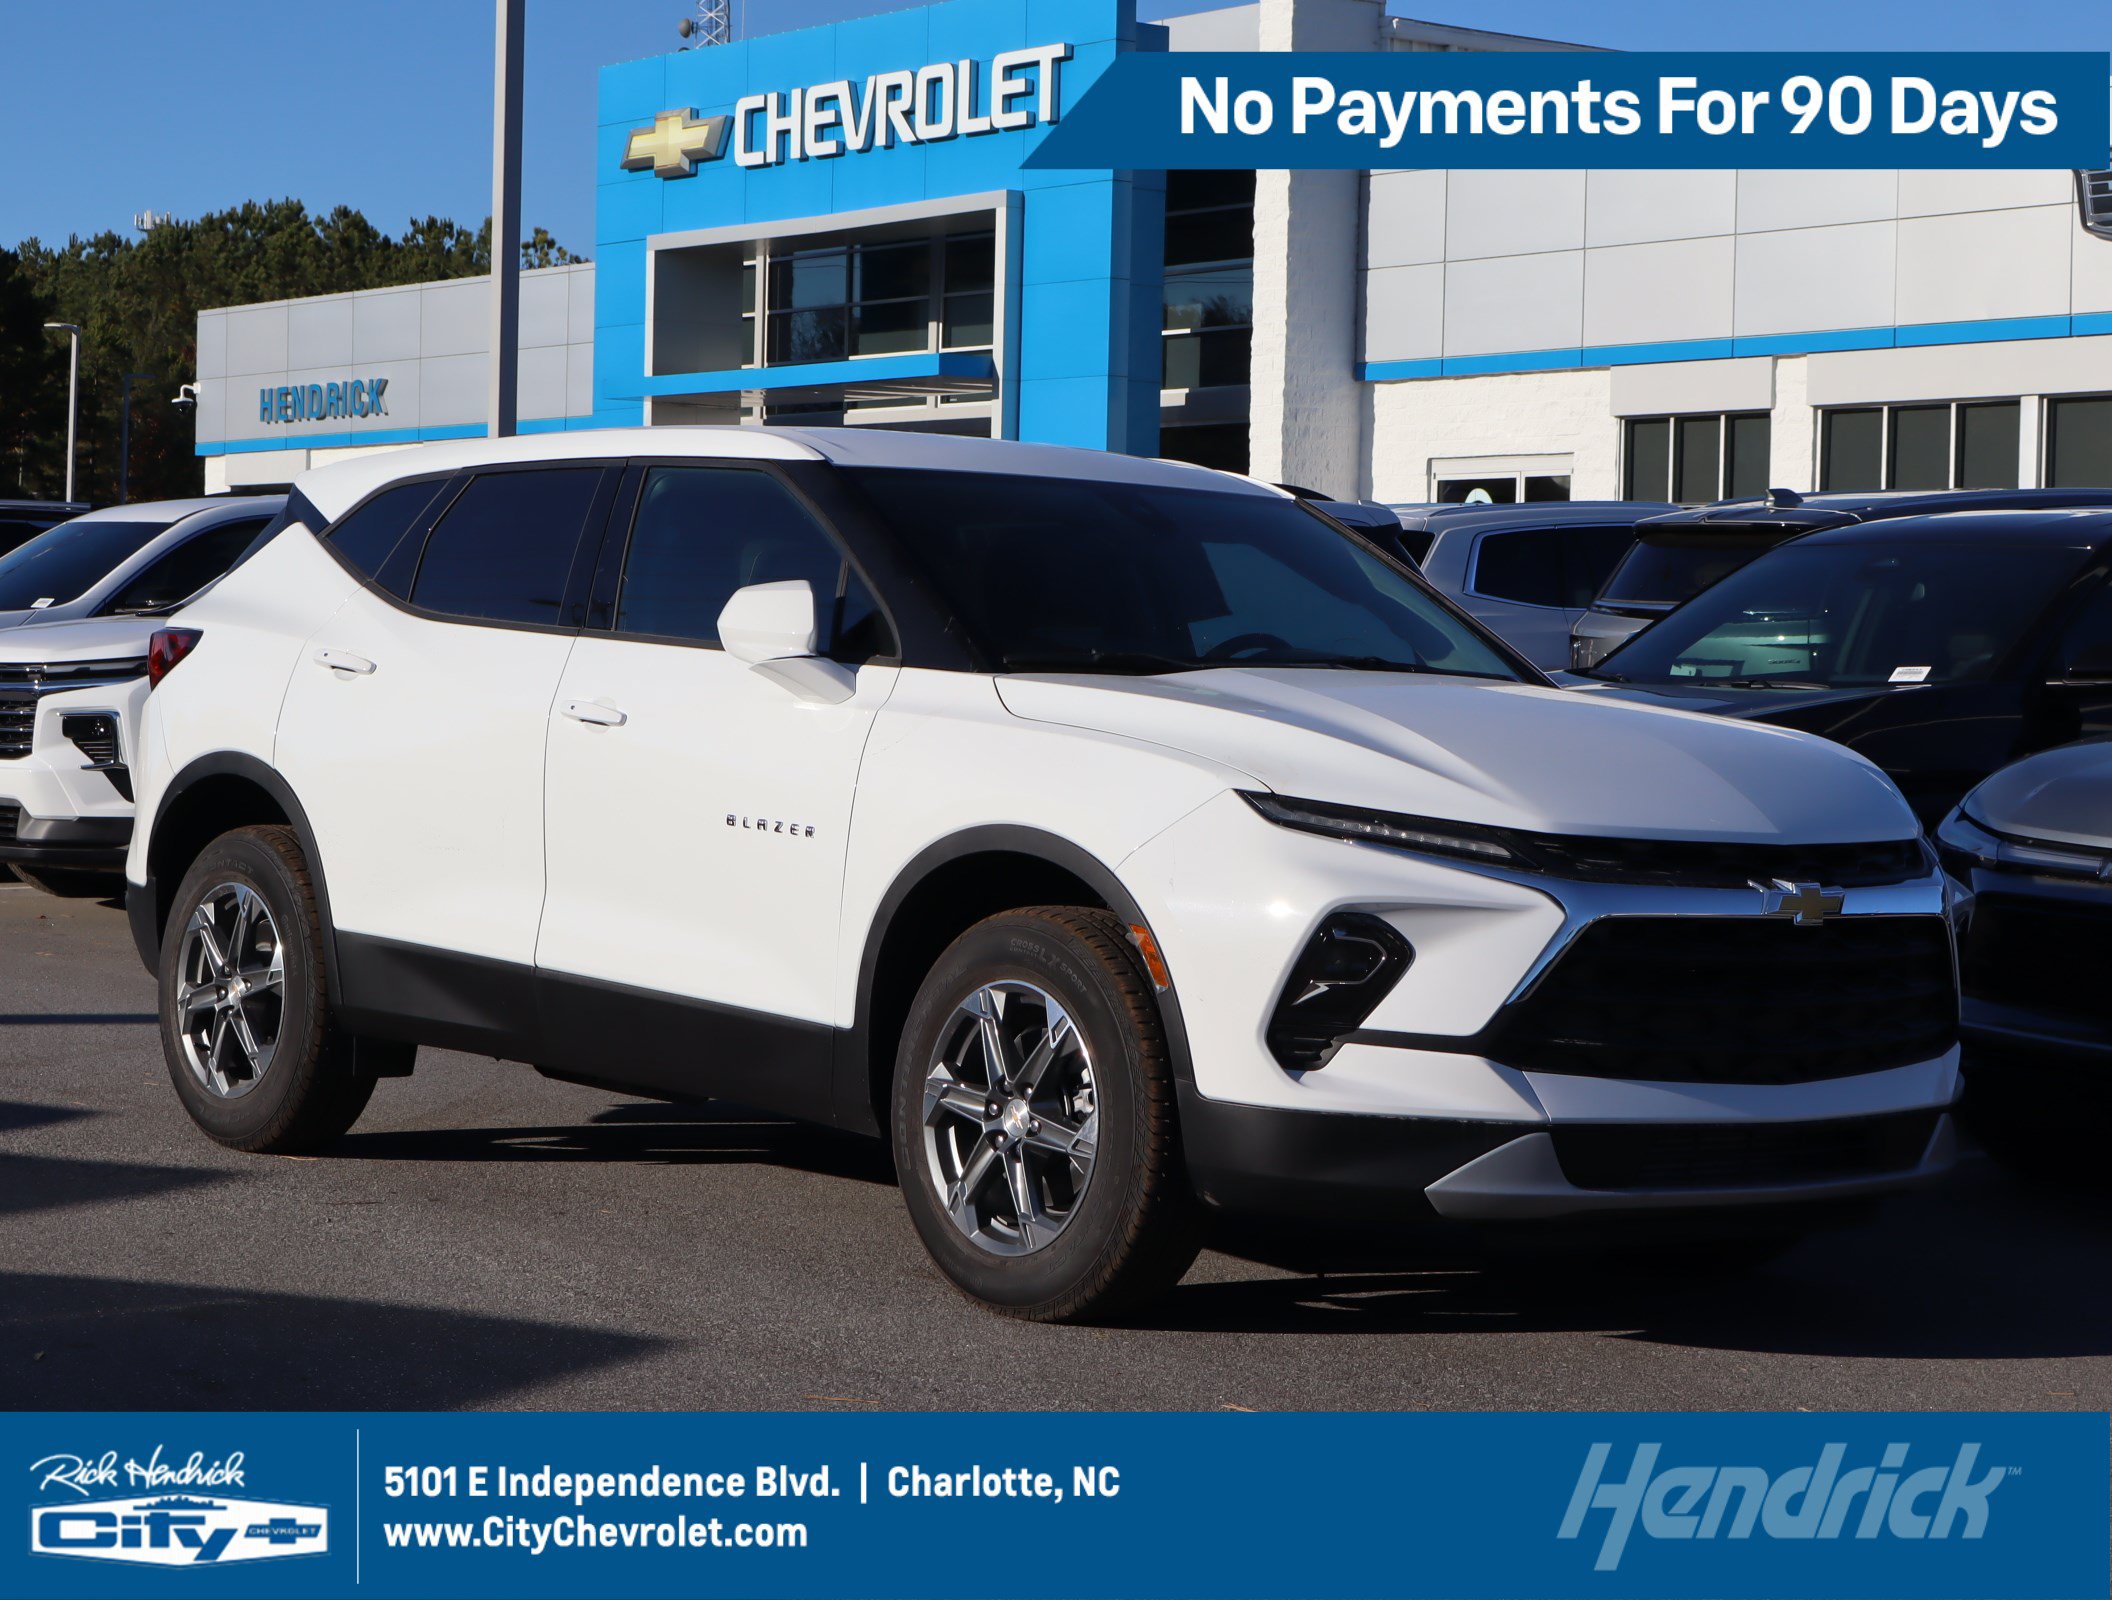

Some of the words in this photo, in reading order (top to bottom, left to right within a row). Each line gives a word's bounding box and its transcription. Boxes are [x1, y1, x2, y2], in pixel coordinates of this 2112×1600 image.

[734, 42, 1073, 168] CHEVROLET
[260, 378, 388, 424] HENDRICK
[726, 813, 816, 838] BLAZER
[1010, 937, 1041, 953] CROSS
[1059, 961, 1088, 993] SPORT
